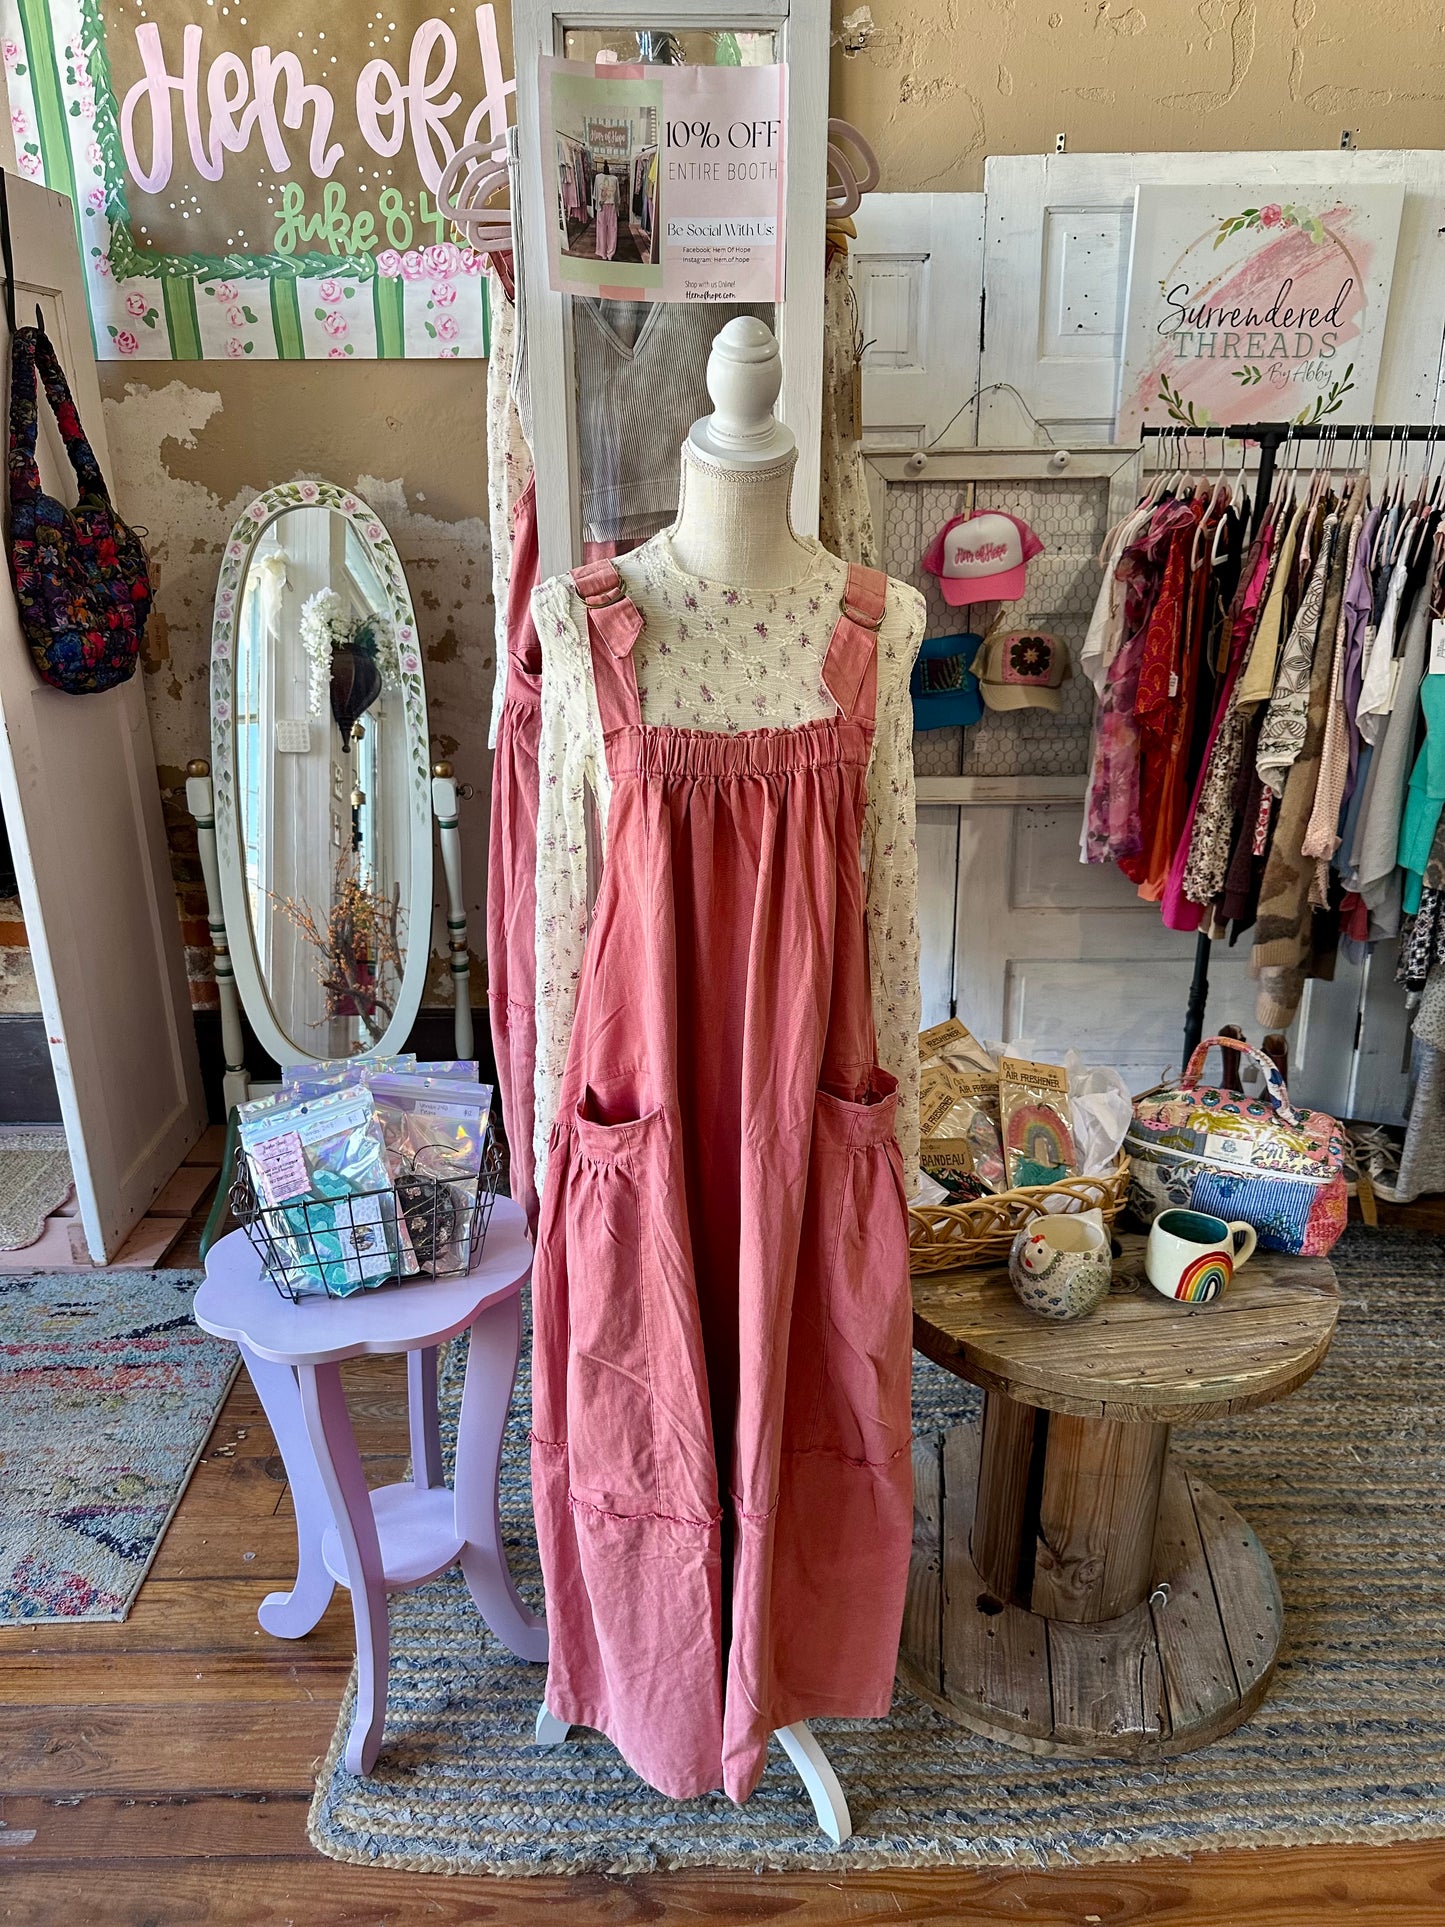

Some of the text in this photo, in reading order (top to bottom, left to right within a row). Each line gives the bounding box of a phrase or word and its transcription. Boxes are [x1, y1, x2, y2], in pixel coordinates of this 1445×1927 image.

[119, 22, 345, 194] Hem
[355, 17, 463, 196] of
[666, 120, 781, 149] 10% OFF
[668, 161, 777, 181] ENTIRE BOOTH
[273, 181, 379, 256] Luke
[667, 222, 775, 237] Be Social With Us:
[735, 246, 751, 255] Hope
[684, 280, 698, 289] Shop
[1157, 278, 1353, 335] Surrendered
[1172, 332, 1338, 358] THREADS
[1266, 360, 1333, 389] By Abby
[925, 1029, 961, 1047] RESHENER
[1005, 1070, 1061, 1088] AIR FRESHENER
[959, 1085, 972, 1094] AIR
[927, 1095, 955, 1125] FRESHENER
[921, 1153, 965, 1167] BANDEAU
